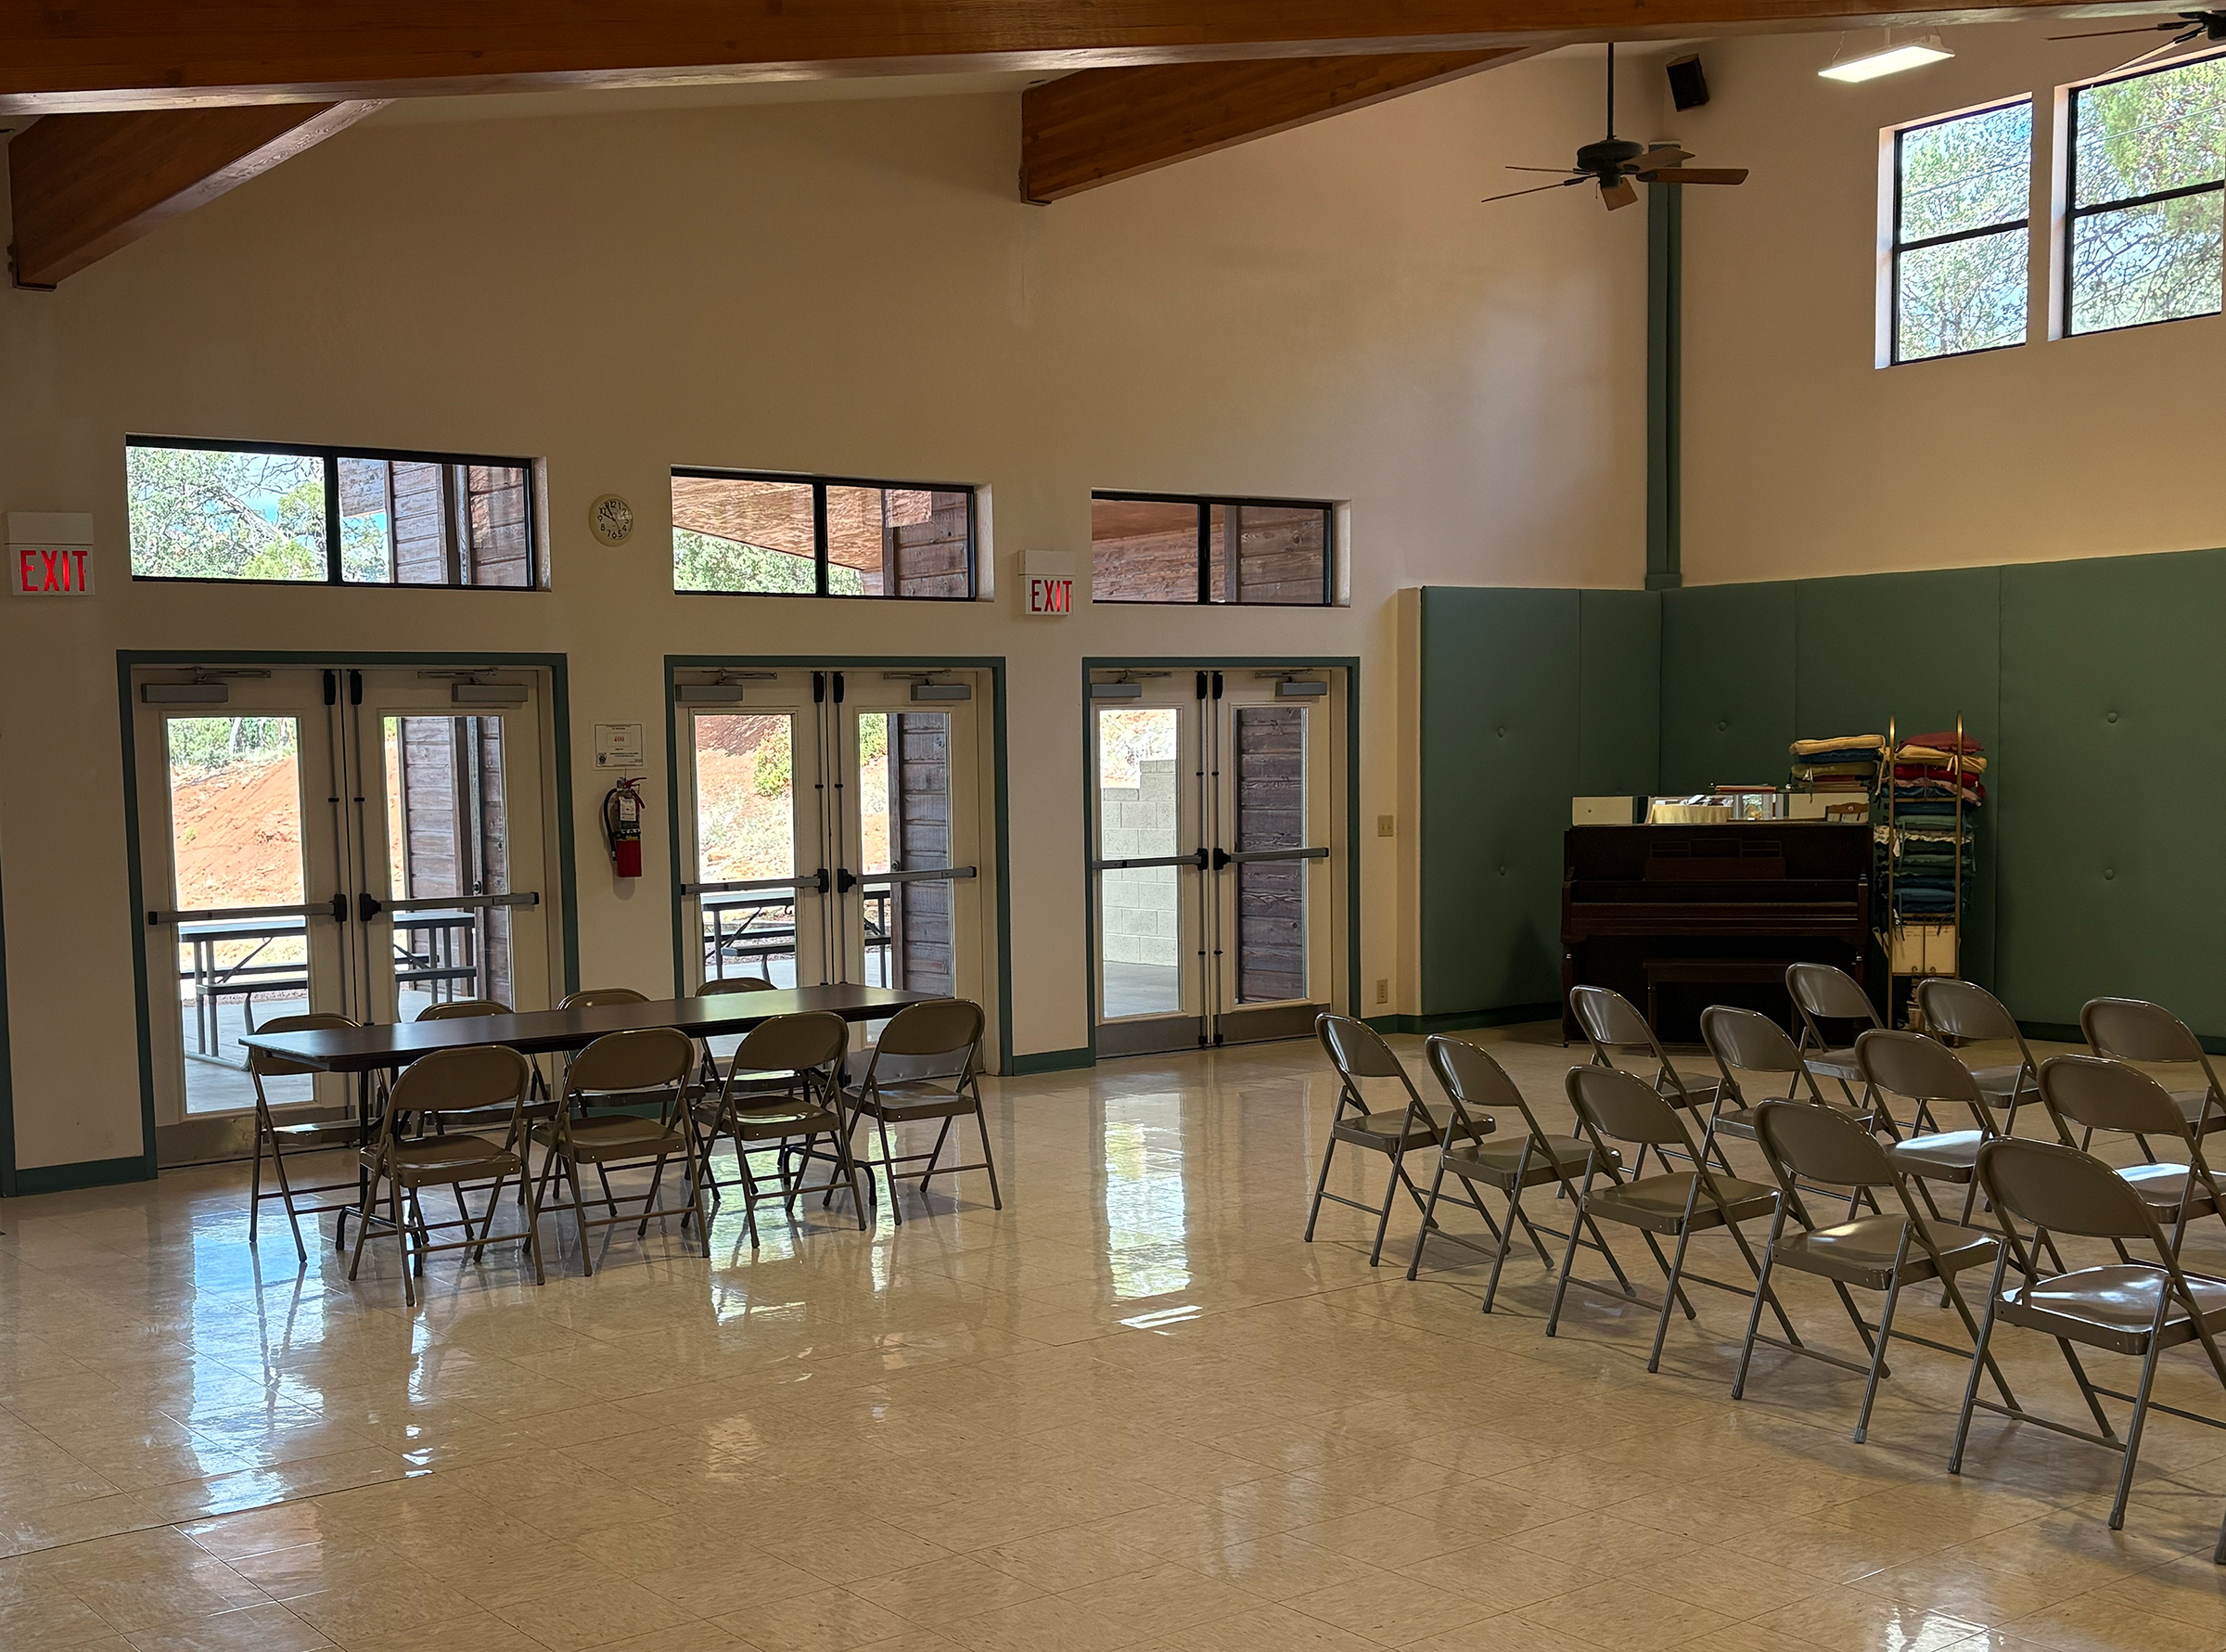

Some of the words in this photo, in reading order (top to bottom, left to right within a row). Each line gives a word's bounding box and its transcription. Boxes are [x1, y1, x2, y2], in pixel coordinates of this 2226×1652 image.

[609, 500, 617, 508] 12
[618, 502, 621, 510] 1
[621, 507, 627, 516] 2
[600, 523, 606, 531] 8
[607, 529, 611, 537] 7
[618, 530, 623, 538] 5
[20, 550, 87, 592] EXIT
[1031, 580, 1072, 612] EXIT
